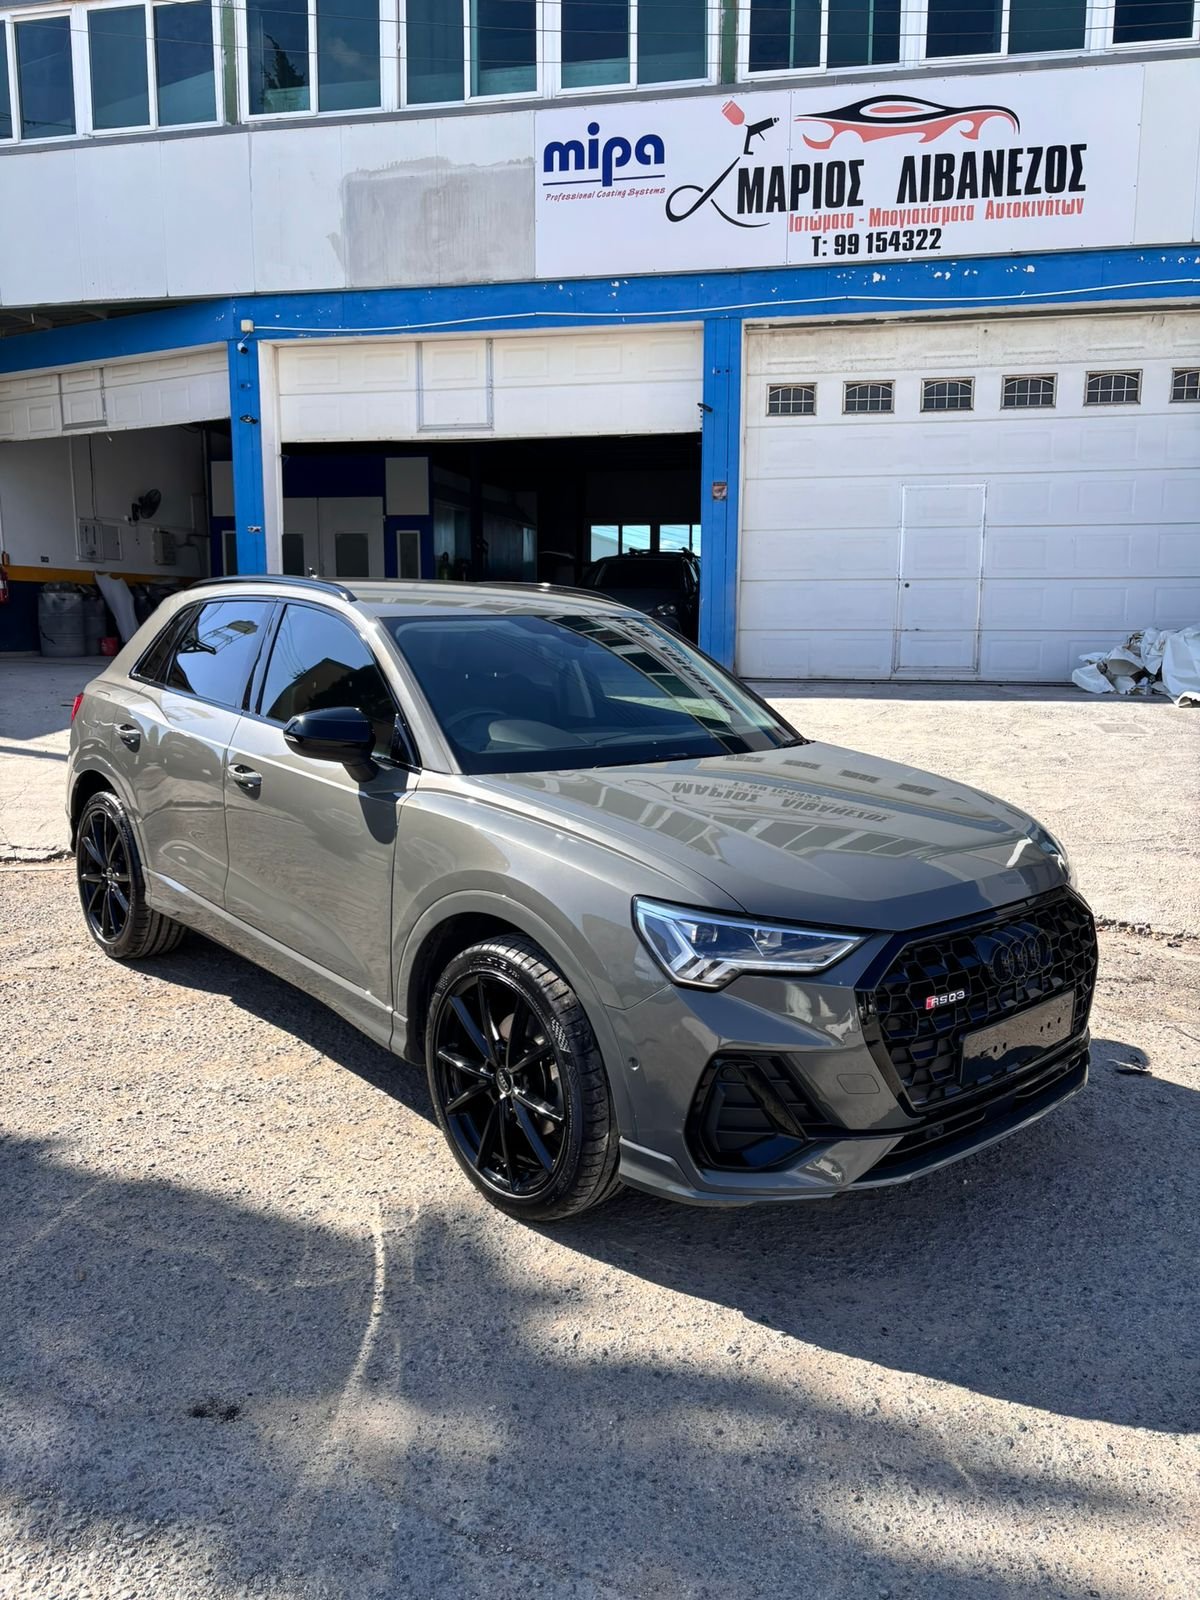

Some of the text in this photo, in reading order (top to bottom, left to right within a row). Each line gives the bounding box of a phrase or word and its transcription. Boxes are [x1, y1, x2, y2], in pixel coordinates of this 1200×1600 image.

[543, 122, 665, 187] mipa
[545, 187, 666, 202] Professional Coating Systems
[737, 143, 1087, 214] ΜΑΡΙΟΣ ΛΙΒΑΝΕΖΟΣ
[789, 211, 854, 233] Ισιώματα
[869, 203, 975, 229] Μπογιατίσματα
[985, 195, 1085, 220] Αυτοκινήτων
[834, 233, 860, 256] 99
[865, 228, 942, 254] 154322
[928, 990, 965, 1008] RSQ3
